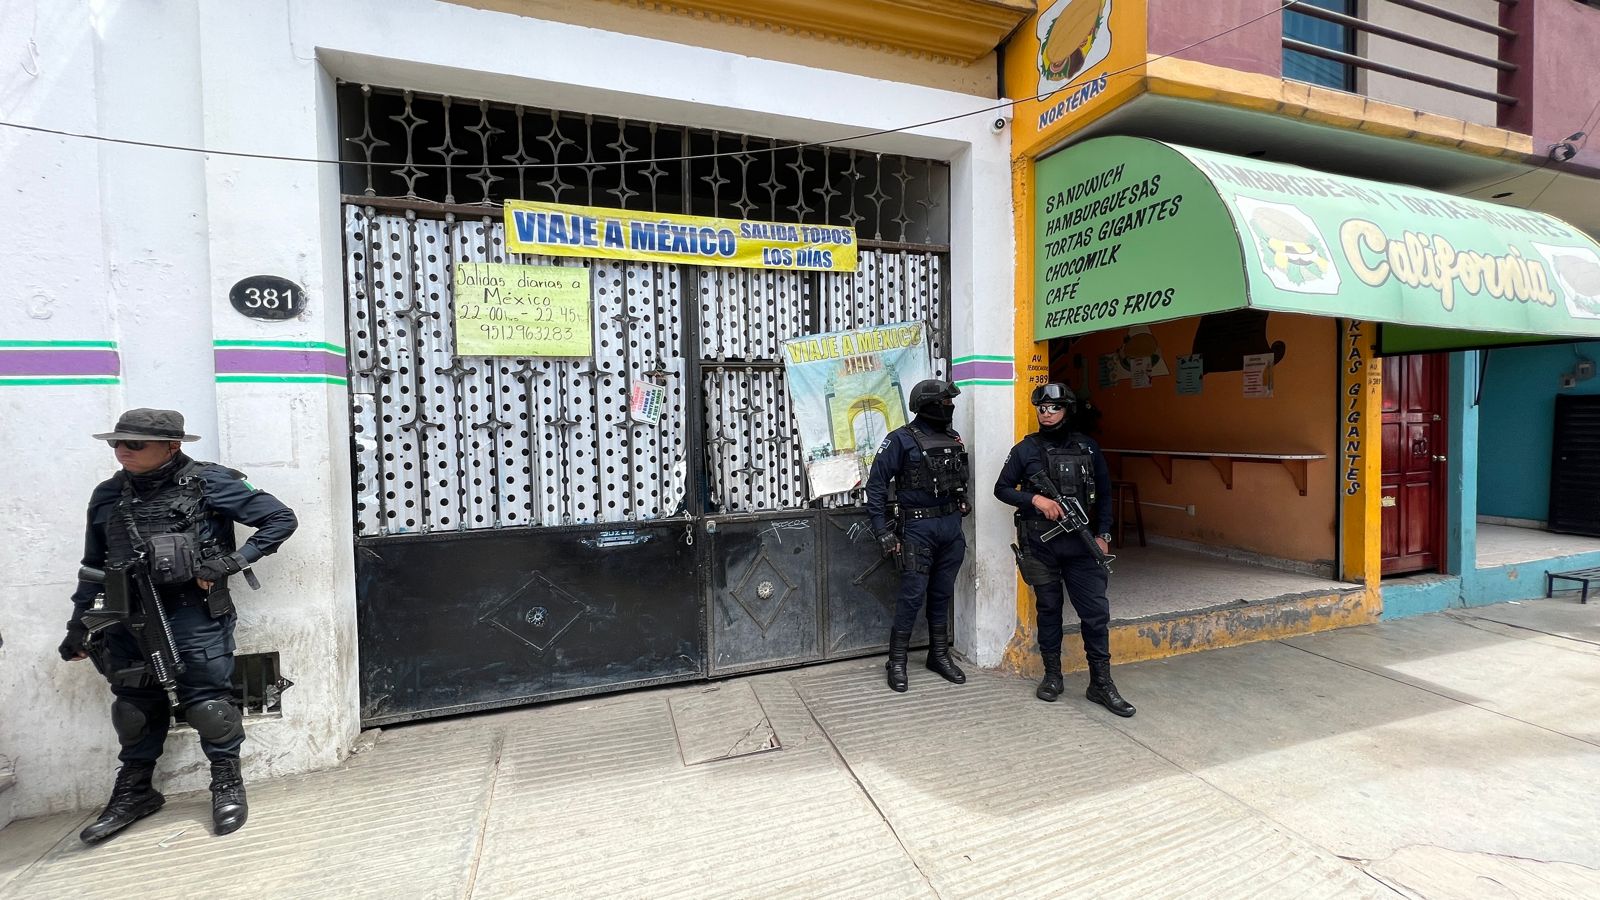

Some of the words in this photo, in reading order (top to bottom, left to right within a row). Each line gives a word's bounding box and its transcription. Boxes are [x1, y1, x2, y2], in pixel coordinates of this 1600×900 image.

[1046, 163, 1125, 214] SANDWICH
[1046, 174, 1161, 237] HAMBURGUESAS
[1370, 188, 1398, 211] Y
[513, 211, 598, 246] VIAJE
[604, 220, 624, 248] A
[630, 220, 736, 256] MÉXICO
[740, 222, 799, 242] SALIDA
[800, 226, 852, 244] TODOS
[1045, 227, 1094, 259] TORTAS
[1098, 194, 1183, 241] GIGANTES
[457, 263, 506, 286] Salidas
[517, 270, 563, 288] diarias
[571, 280, 581, 288] a
[763, 248, 793, 266] LOS
[796, 247, 833, 268] DÍAS
[1045, 244, 1121, 282] CHOCOMILK
[1339, 218, 1557, 312] California
[245, 287, 293, 309] 381
[484, 287, 551, 306] México
[1045, 298, 1119, 328] REFRESCOS
[1123, 287, 1175, 315] FRIOS
[1046, 277, 1080, 305] CAFÉ
[480, 324, 573, 340] 9512963283
[787, 335, 840, 363] VIAJE
[842, 334, 855, 356] A
[856, 322, 922, 353] MÉXICO
[1346, 382, 1361, 496] GIGANTES
